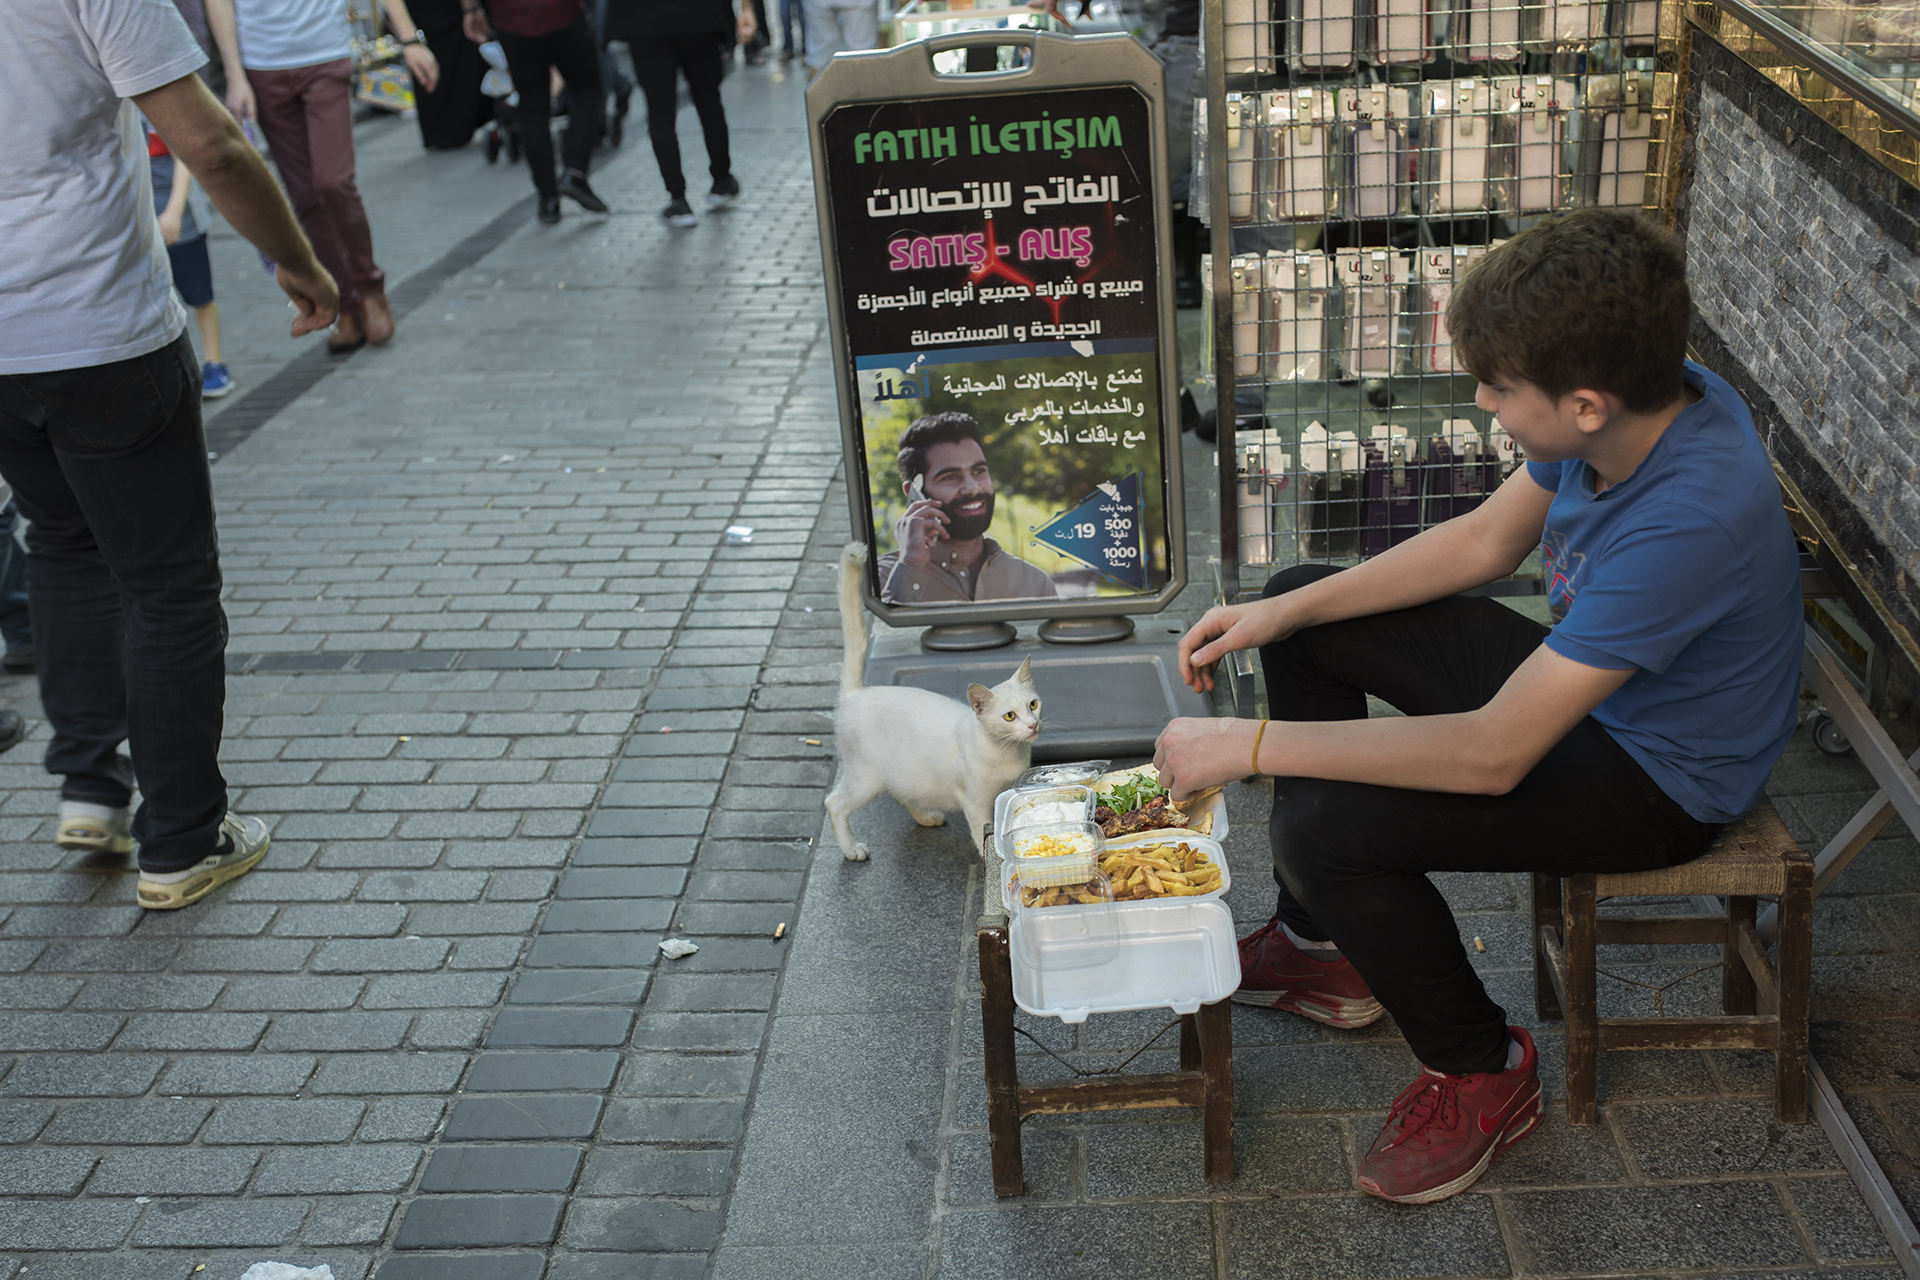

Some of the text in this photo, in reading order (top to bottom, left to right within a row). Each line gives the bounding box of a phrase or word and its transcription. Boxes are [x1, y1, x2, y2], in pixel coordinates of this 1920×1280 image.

[854, 126, 957, 164] FATIH
[866, 174, 1119, 219] الفاتح للإتصالات
[888, 233, 986, 273] SATIŞ
[1019, 227, 1093, 267] ALIŞ
[857, 275, 1144, 313] مبيع و شراء جميع أنواع الأجهزة
[910, 319, 1101, 346] الجديدة و المستعملة
[943, 368, 1143, 399] تمتع بالإتصالات المجانية
[1004, 396, 1145, 426] والخدمات بالعربي
[1075, 424, 1118, 446] باقات
[1122, 429, 1146, 449] مع
[1111, 491, 1121, 503] 4
[1074, 522, 1096, 539] 19
[1104, 518, 1132, 531] 500
[1103, 546, 1137, 559] 1000
[1109, 558, 1131, 568] رسالة
